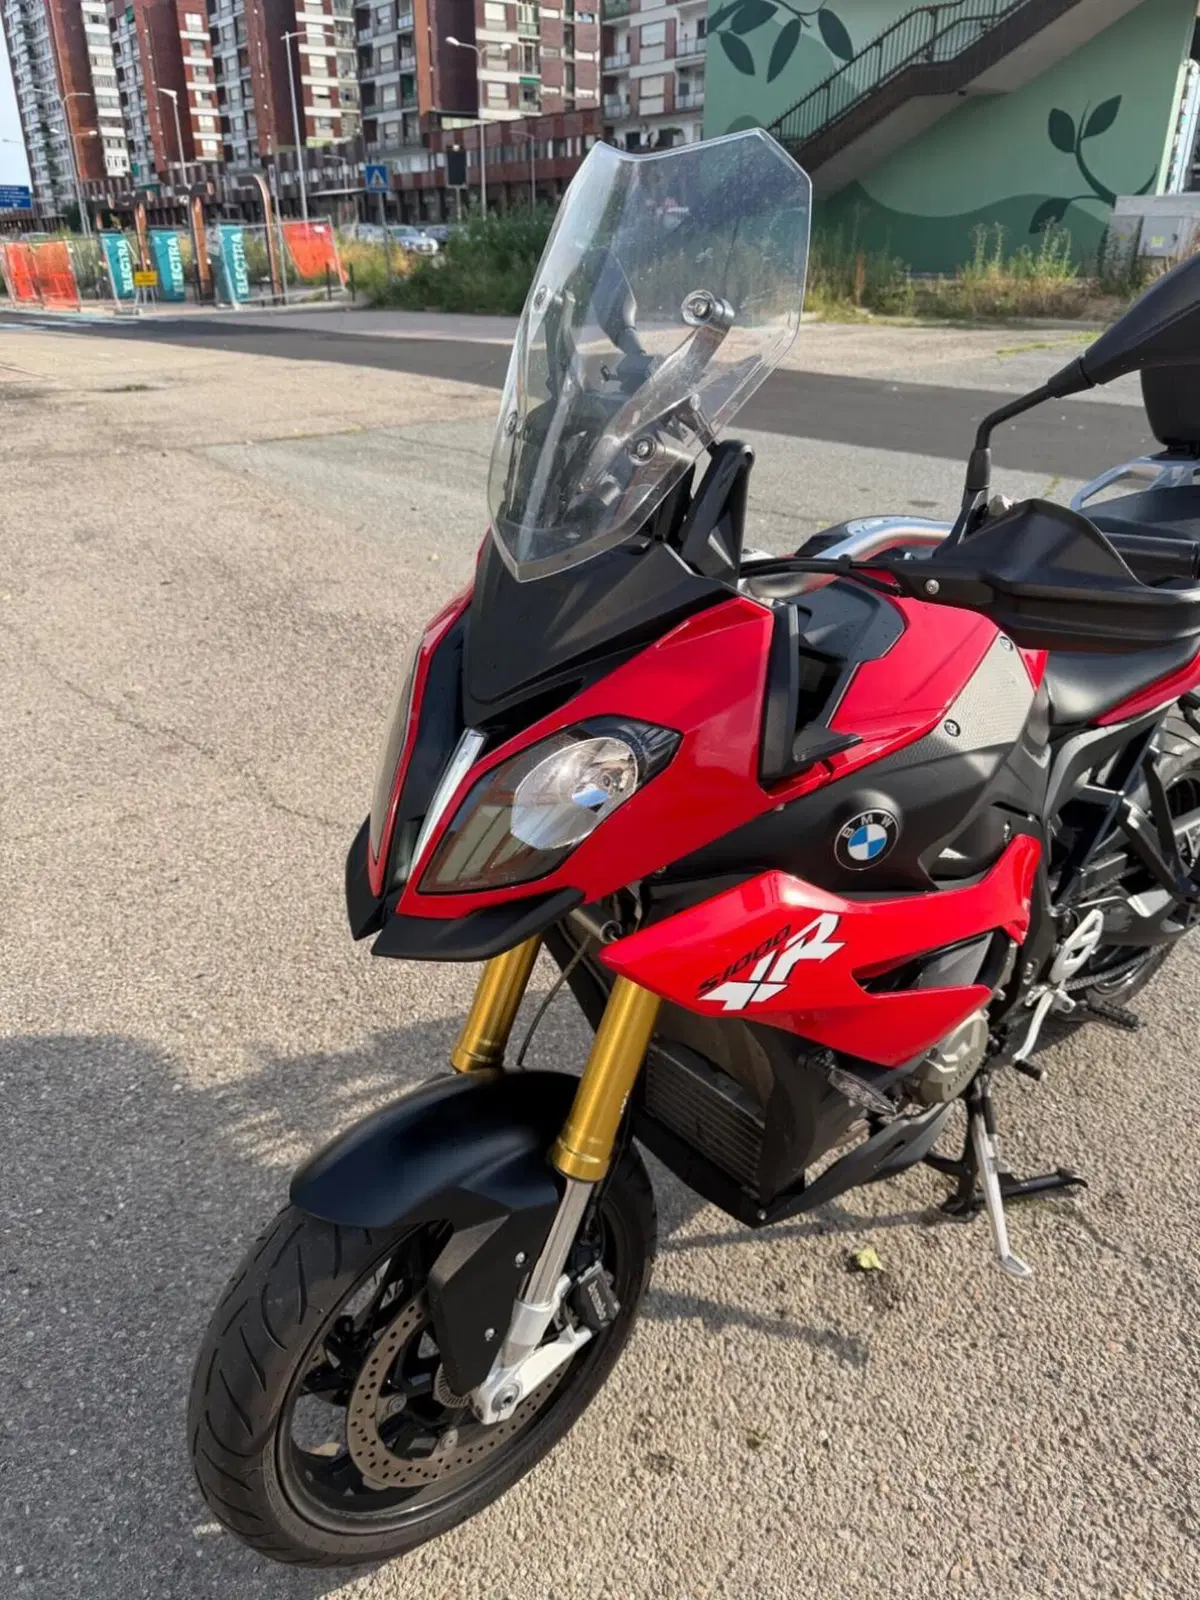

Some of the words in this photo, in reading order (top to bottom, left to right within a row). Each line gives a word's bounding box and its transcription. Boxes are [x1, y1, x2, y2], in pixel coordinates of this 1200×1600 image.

[117, 239, 134, 294] ELECTRA
[167, 237, 185, 293] ELECTRA
[231, 232, 249, 295] ELECTRA
[841, 813, 893, 839] BMW
[698, 912, 847, 1011] XR
